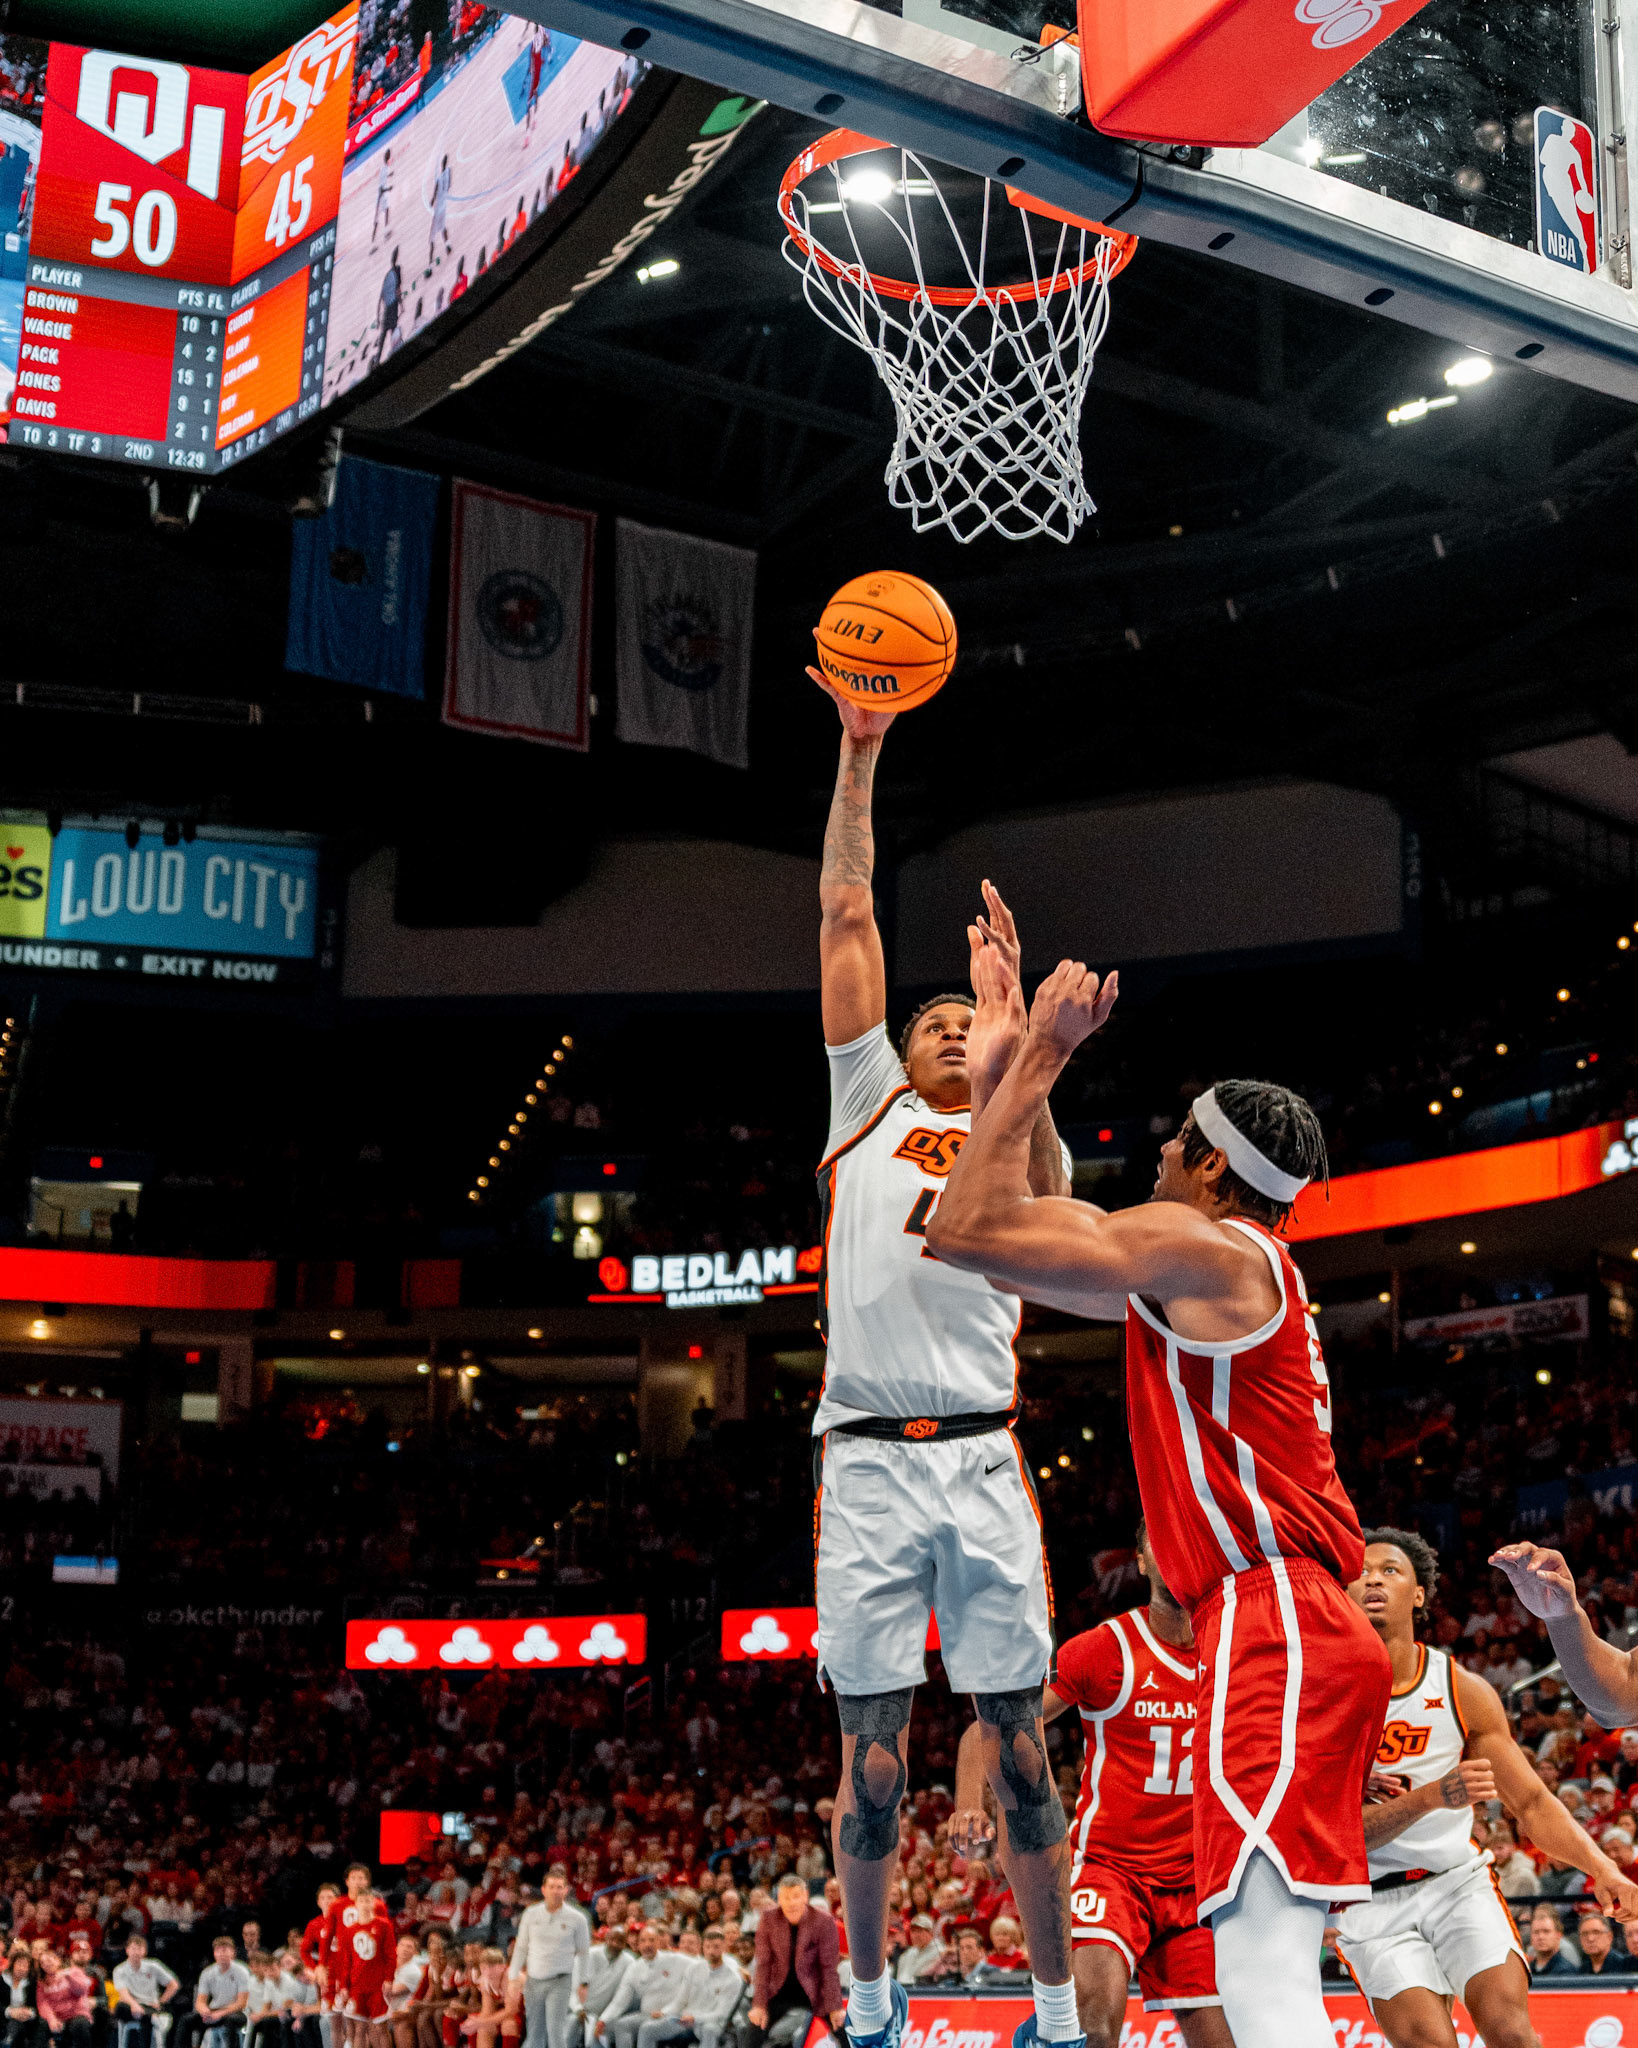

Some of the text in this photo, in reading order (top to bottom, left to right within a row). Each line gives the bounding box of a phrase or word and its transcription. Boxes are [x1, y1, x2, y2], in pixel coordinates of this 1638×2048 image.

[90, 180, 178, 267] 50
[264, 154, 315, 249] 45
[1547, 228, 1577, 264] NBA
[31, 264, 225, 311] PLAYER PTS FL
[231, 278, 261, 309] PLAYER
[309, 236, 325, 258] PTS
[26, 290, 219, 336] BROWN 10 1
[23, 316, 217, 363] WAGUE 4 2
[20, 343, 214, 388] PACK 15 1
[17, 370, 212, 415] JONES 9 1
[15, 396, 210, 442] DAVIS 2 1
[22, 426, 102, 454] TO 3 TF 3
[124, 441, 155, 461] 2ND
[167, 447, 208, 470] 12:29
[833, 618, 885, 645] EVO
[820, 652, 901, 694] Wilson
[59, 850, 307, 940] LOUD CITY
[0, 942, 278, 982] UNDER EXIT NOW
[892, 1127, 970, 1178] OS
[631, 1245, 798, 1293] BEDLAM
[665, 1285, 764, 1309] BASKETBALL
[903, 1418, 939, 1439] OSU
[1133, 1700, 1197, 1720] OKLAH
[1375, 1720, 1433, 1766] SU
[1071, 1888, 1107, 1923] OU
